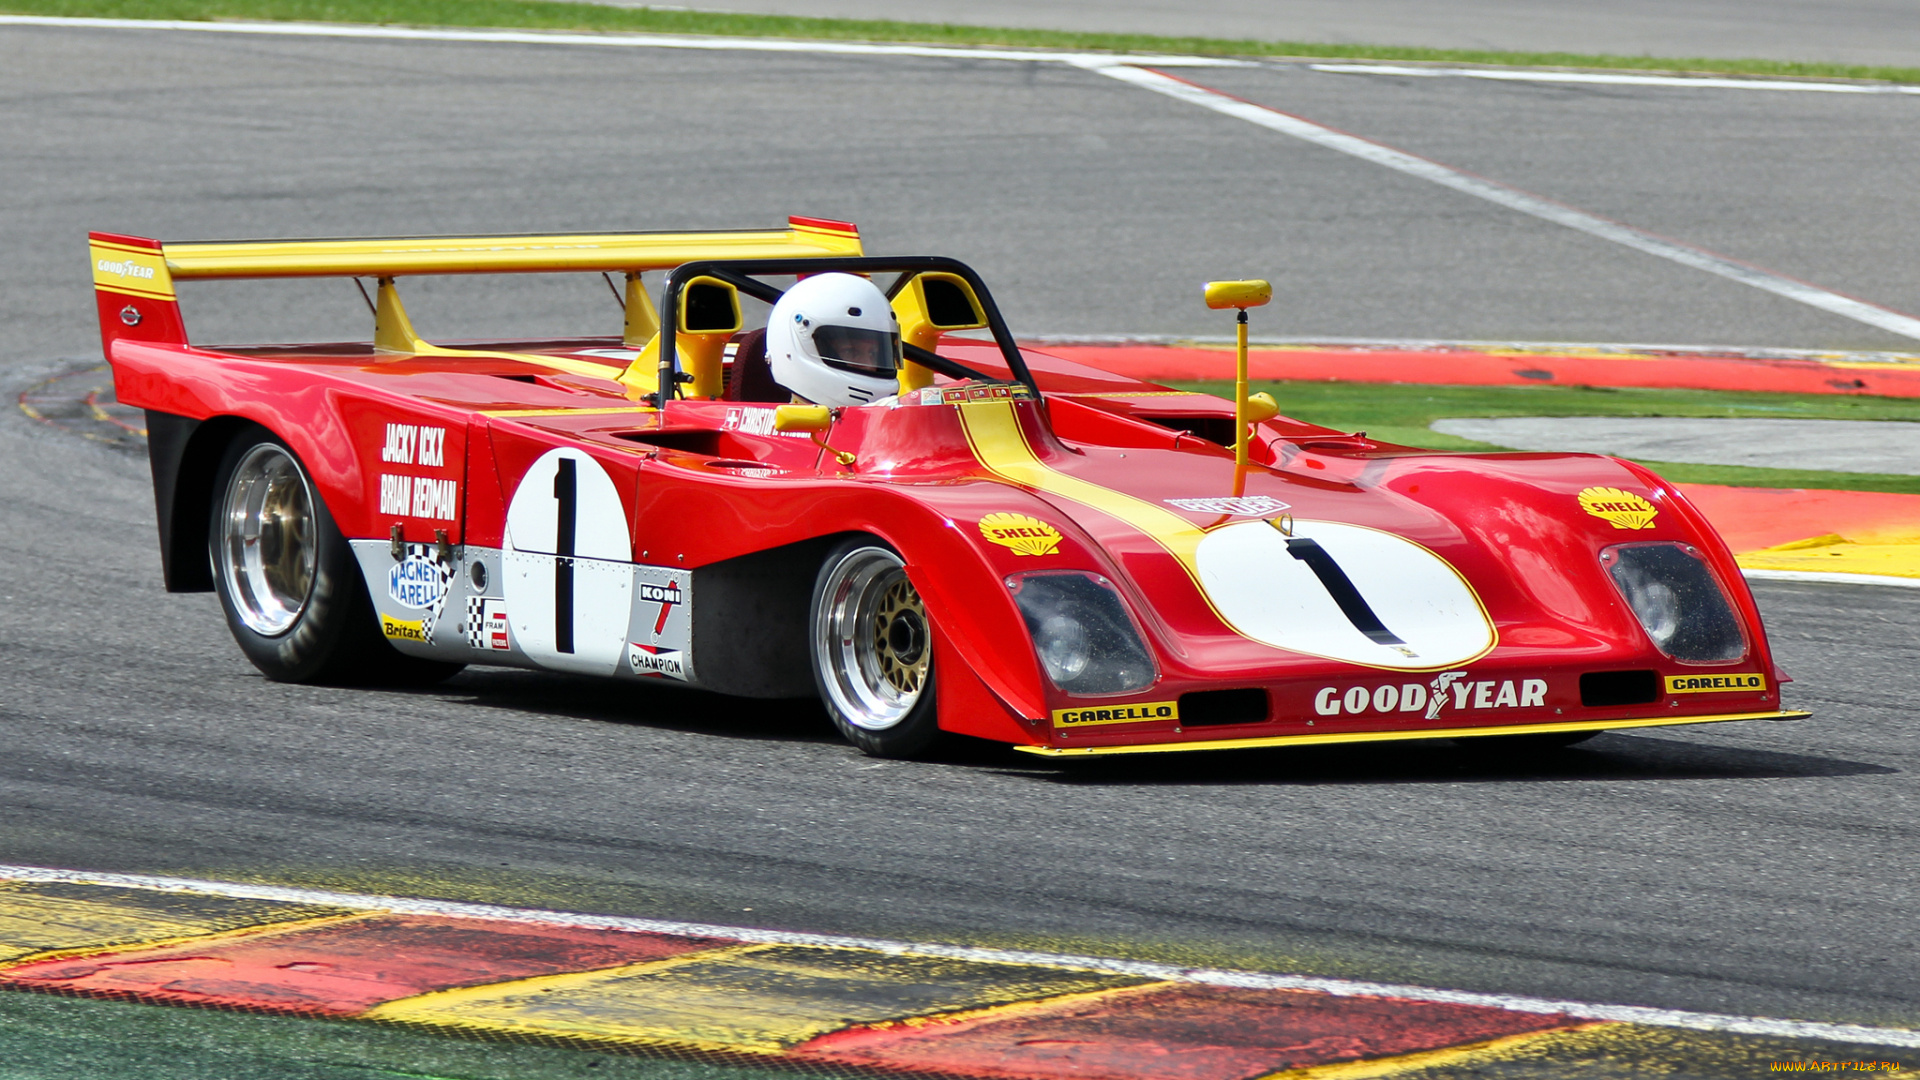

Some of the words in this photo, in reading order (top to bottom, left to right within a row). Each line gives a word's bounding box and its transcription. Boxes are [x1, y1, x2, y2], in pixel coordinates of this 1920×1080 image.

[382, 423, 418, 464] JACKY
[419, 426, 446, 467] ICKX
[380, 473, 411, 516] BRIAN
[412, 476, 457, 521] REDMAN
[1591, 502, 1648, 513] SHELL
[991, 527, 1052, 540] SHELL
[554, 457, 577, 654] 1
[390, 561, 440, 582] MAGNETI
[390, 582, 440, 606] MARELLI
[641, 586, 681, 603] KONI
[1283, 537, 1408, 645] 1
[384, 622, 422, 639] Britax
[485, 621, 504, 630] FRAM
[631, 654, 682, 673] CHAMPION
[1672, 676, 1760, 690] CARELLO
[1061, 706, 1172, 724] CARELLO
